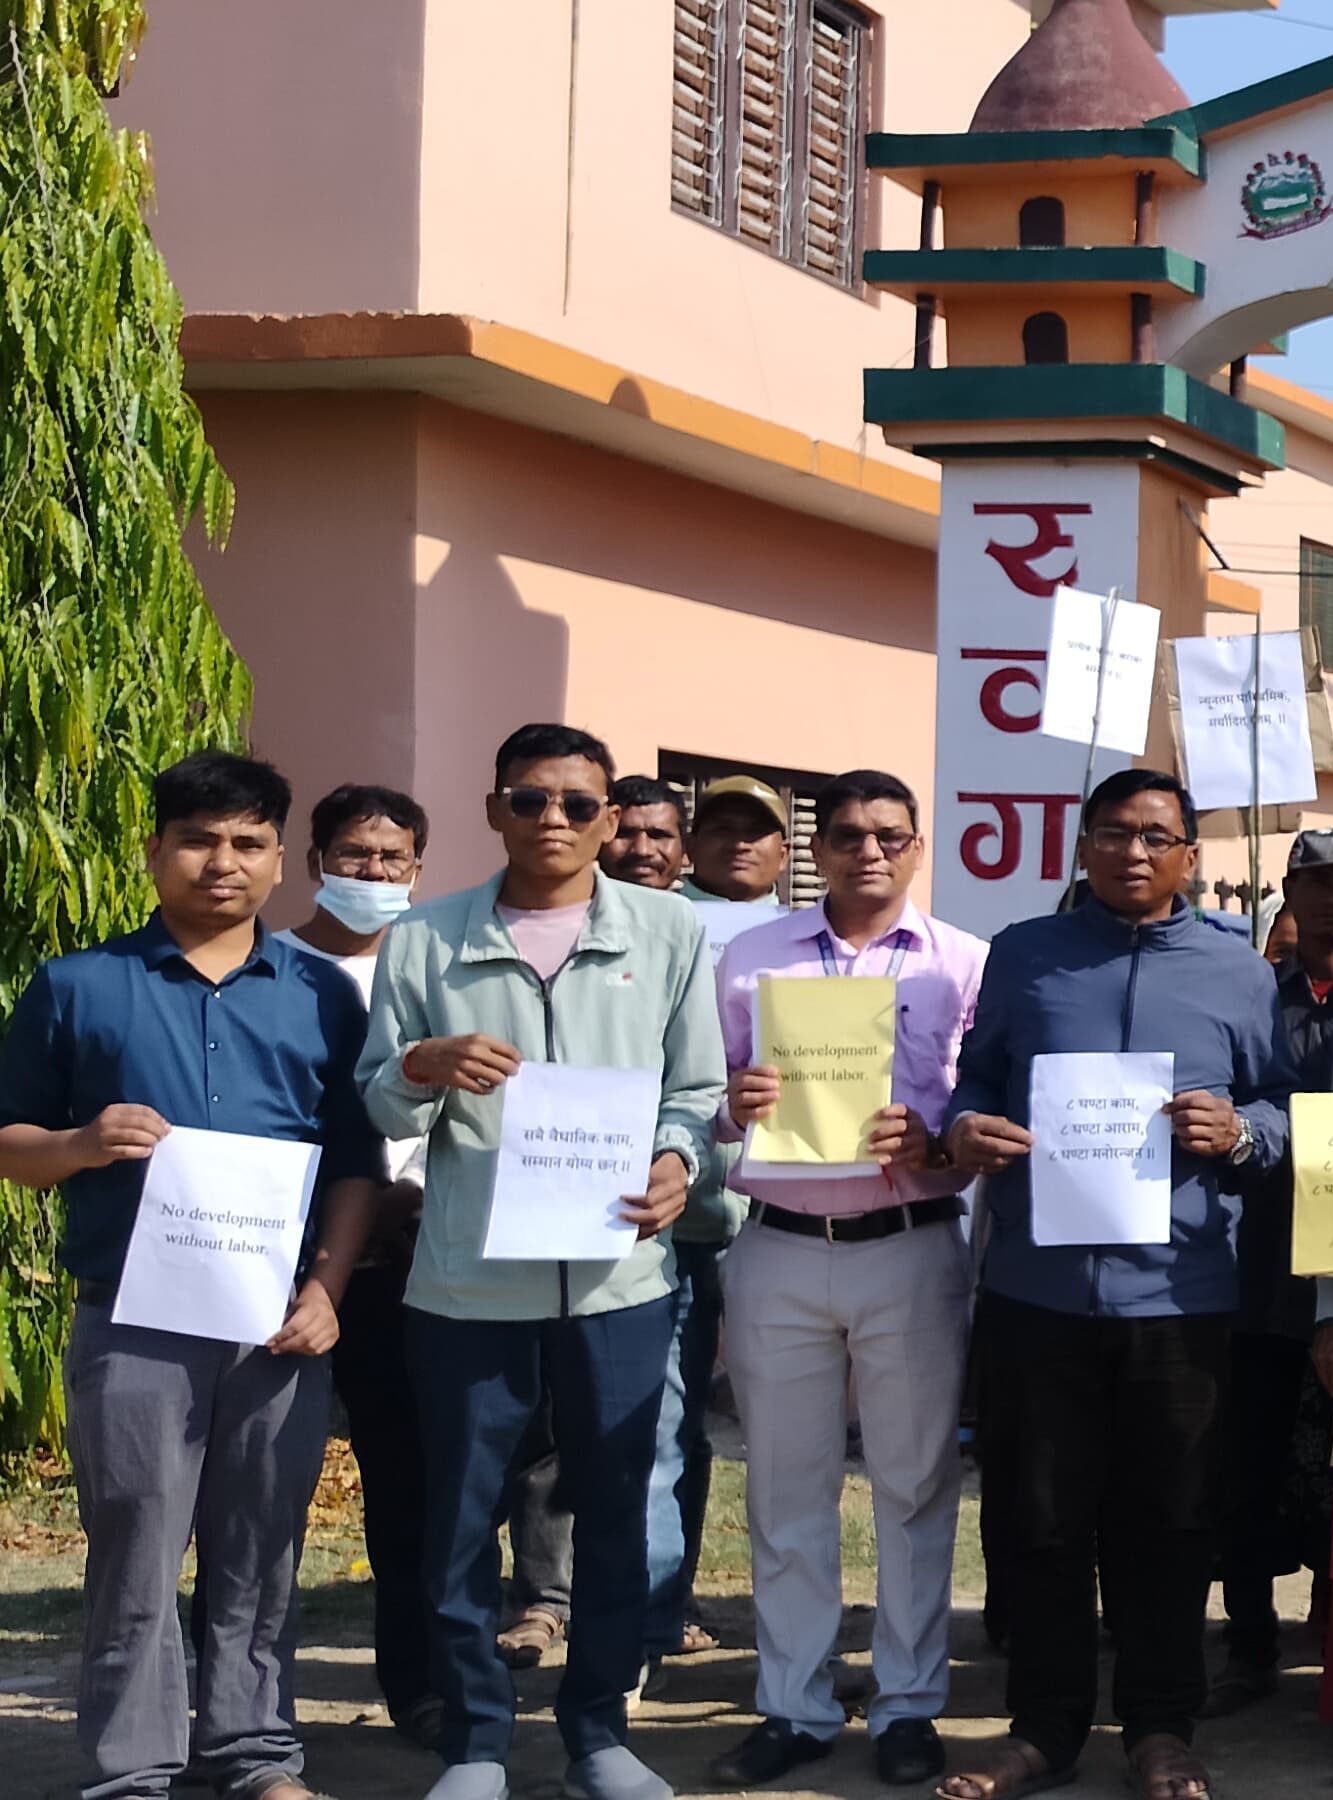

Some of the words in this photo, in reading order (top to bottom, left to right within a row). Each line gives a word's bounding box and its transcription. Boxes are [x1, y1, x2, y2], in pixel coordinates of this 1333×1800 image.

[772, 1045, 790, 1057] No
[793, 1044, 878, 1059] development
[780, 1068, 829, 1082] without
[832, 1068, 869, 1082] labor.
[1066, 1099, 1075, 1110] ८
[1078, 1098, 1107, 1111] घण्टा
[1110, 1097, 1139, 1111] काम,
[1060, 1124, 1069, 1136] ८
[1072, 1122, 1100, 1135] घण्टा
[1104, 1122, 1144, 1136] आराम,
[1061, 1148, 1088, 1160] घण्टा
[161, 1202, 185, 1218] No
[189, 1206, 287, 1230] development
[165, 1232, 223, 1252] without
[228, 1237, 270, 1256] labor.
